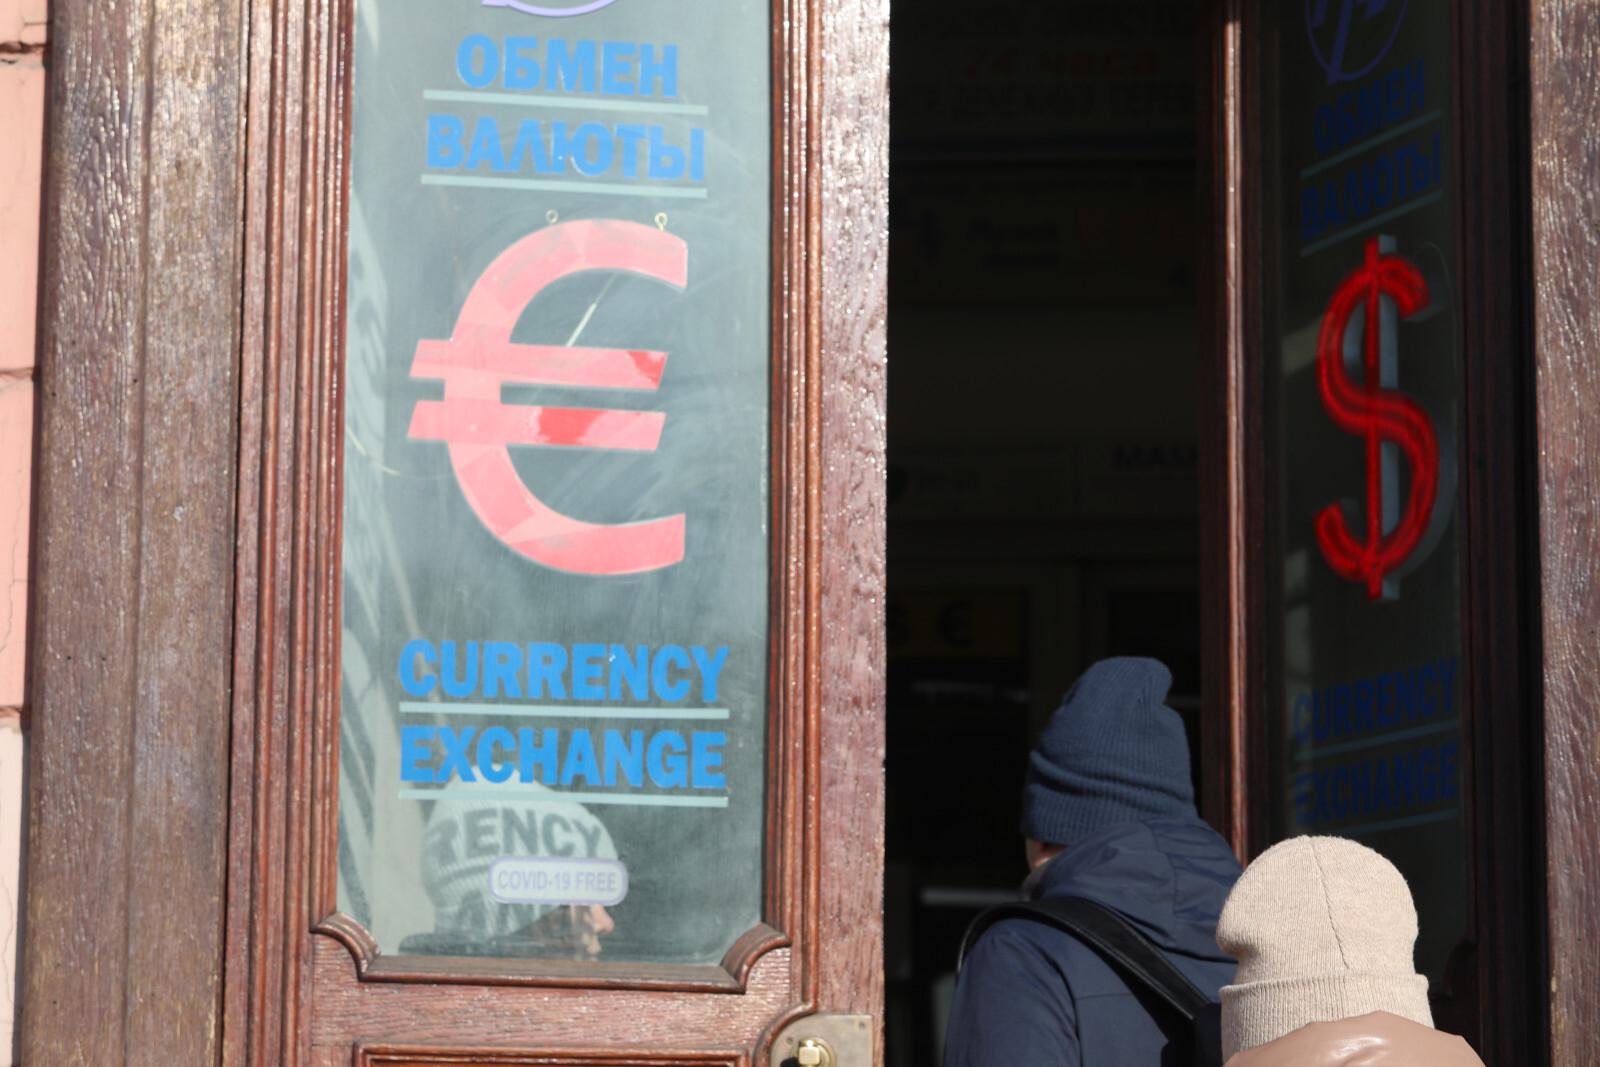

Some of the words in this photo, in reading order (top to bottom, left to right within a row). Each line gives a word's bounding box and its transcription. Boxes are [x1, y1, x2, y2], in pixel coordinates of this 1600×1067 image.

[455, 33, 680, 97] ОБМЕН
[1314, 55, 1425, 156] ОБМЕН
[426, 112, 705, 181] ВАЛЮТЫ
[1301, 130, 1441, 240] ВАЛЮТЫ
[406, 218, 688, 576] €
[1313, 235, 1438, 600] $
[400, 639, 730, 703] CURRENCY
[1295, 657, 1456, 747] CURRENCY
[400, 726, 728, 789] EXCHANGE
[1295, 740, 1456, 826] EXCHANGE
[498, 869, 571, 892] COVID-19
[575, 872, 616, 892] FREE
